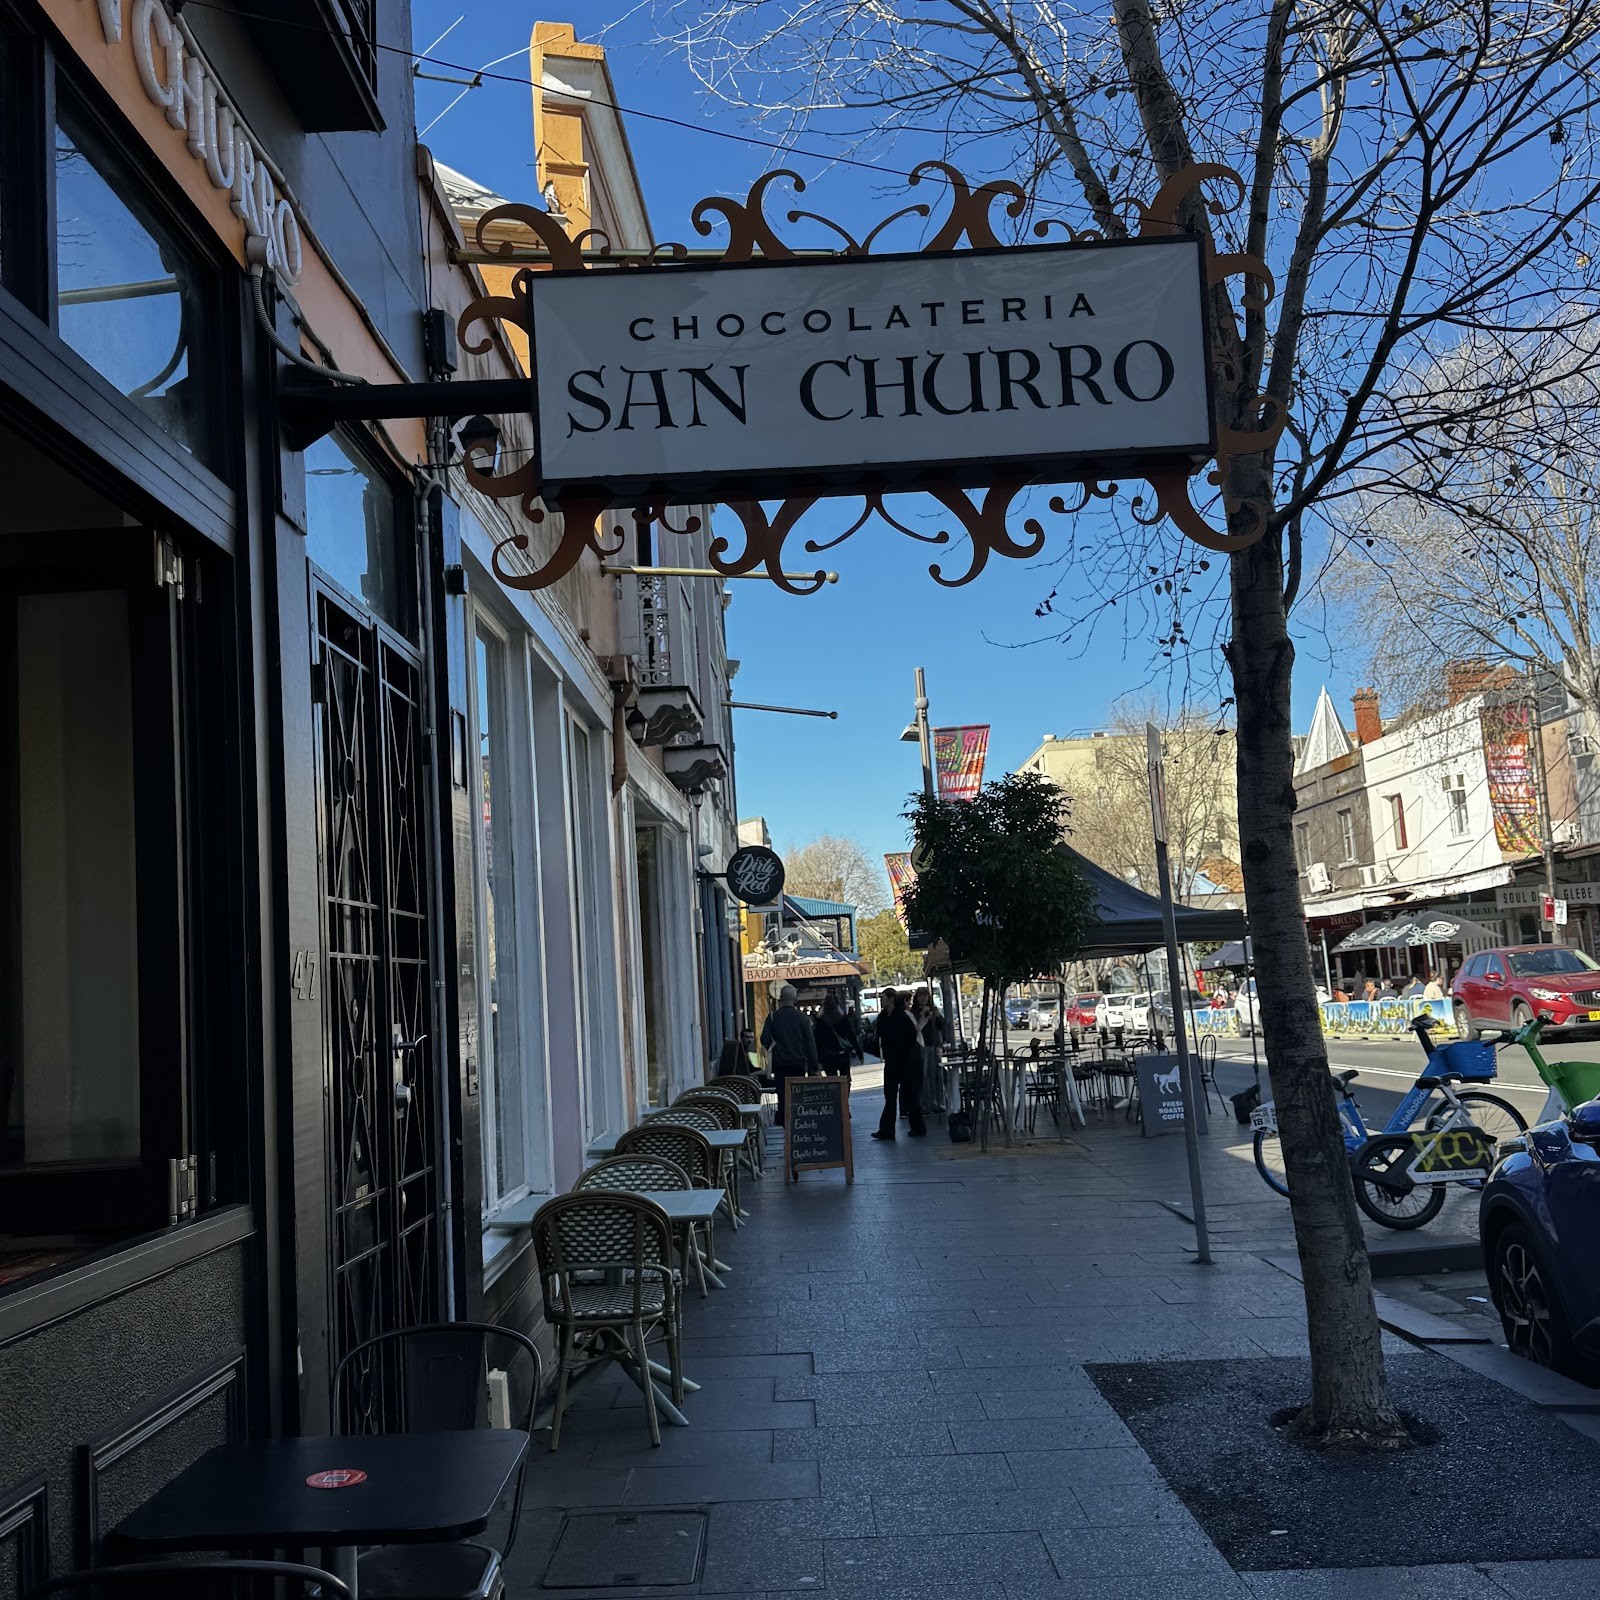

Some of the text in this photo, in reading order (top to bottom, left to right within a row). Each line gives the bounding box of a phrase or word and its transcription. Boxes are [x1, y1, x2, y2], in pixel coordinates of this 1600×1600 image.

[131, 0, 303, 287] CHURRO
[628, 292, 1097, 342] CHOCOLATERIA
[565, 338, 1176, 440] SAN CHURRO
[733, 853, 779, 881] Dirty
[735, 871, 771, 895] Red
[1503, 891, 1527, 904] SOUL
[1563, 887, 1593, 900] GLEBE
[292, 950, 318, 1001] 47
[747, 966, 831, 980] BADDE MANORS
